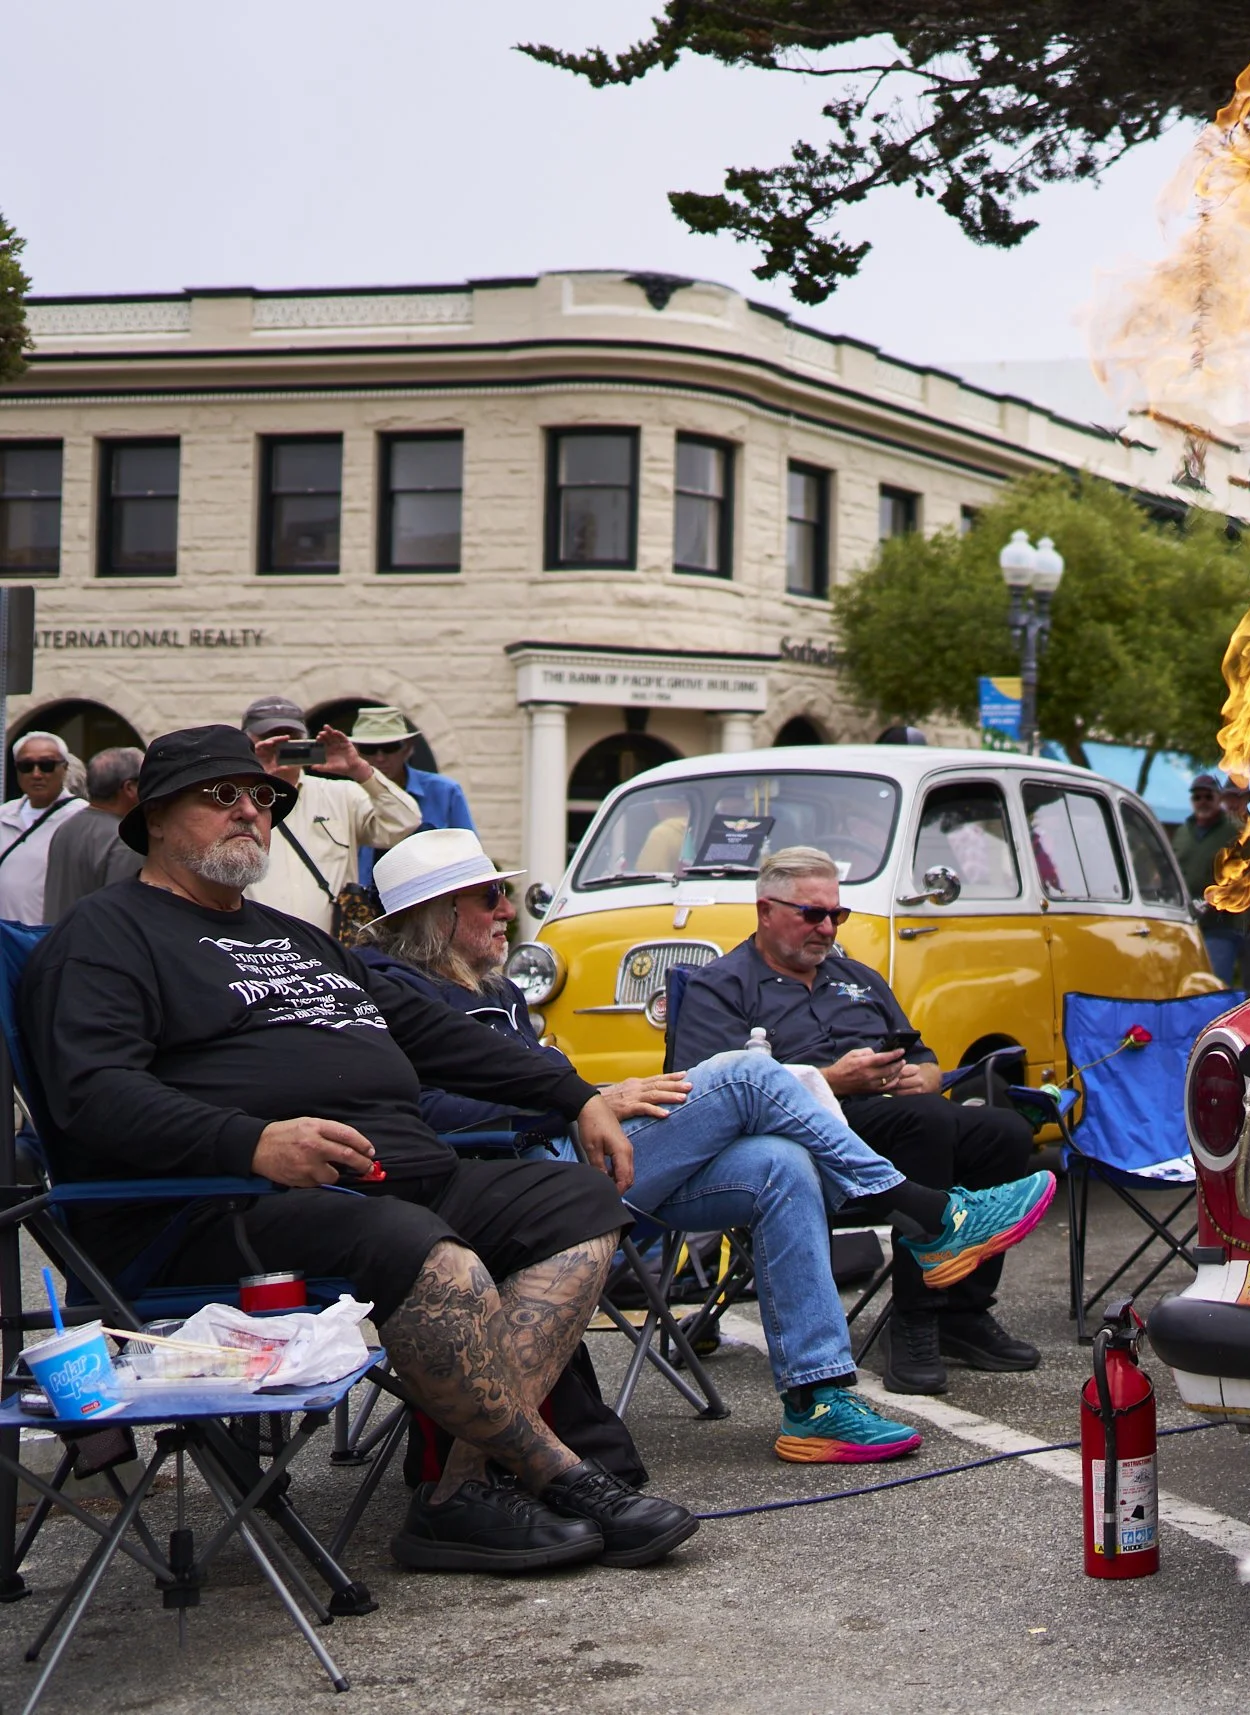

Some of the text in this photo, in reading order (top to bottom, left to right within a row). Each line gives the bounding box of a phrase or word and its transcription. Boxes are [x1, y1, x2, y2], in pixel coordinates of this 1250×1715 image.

[34, 629, 263, 649] TERNATIONAL REALTY
[542, 670, 759, 693] THE BANK OF PACIFIC GROVE BUILDING
[235, 952, 302, 965] TATTOOED
[235, 958, 322, 977] FOR THE KIDS
[49, 1355, 88, 1393] Polar
